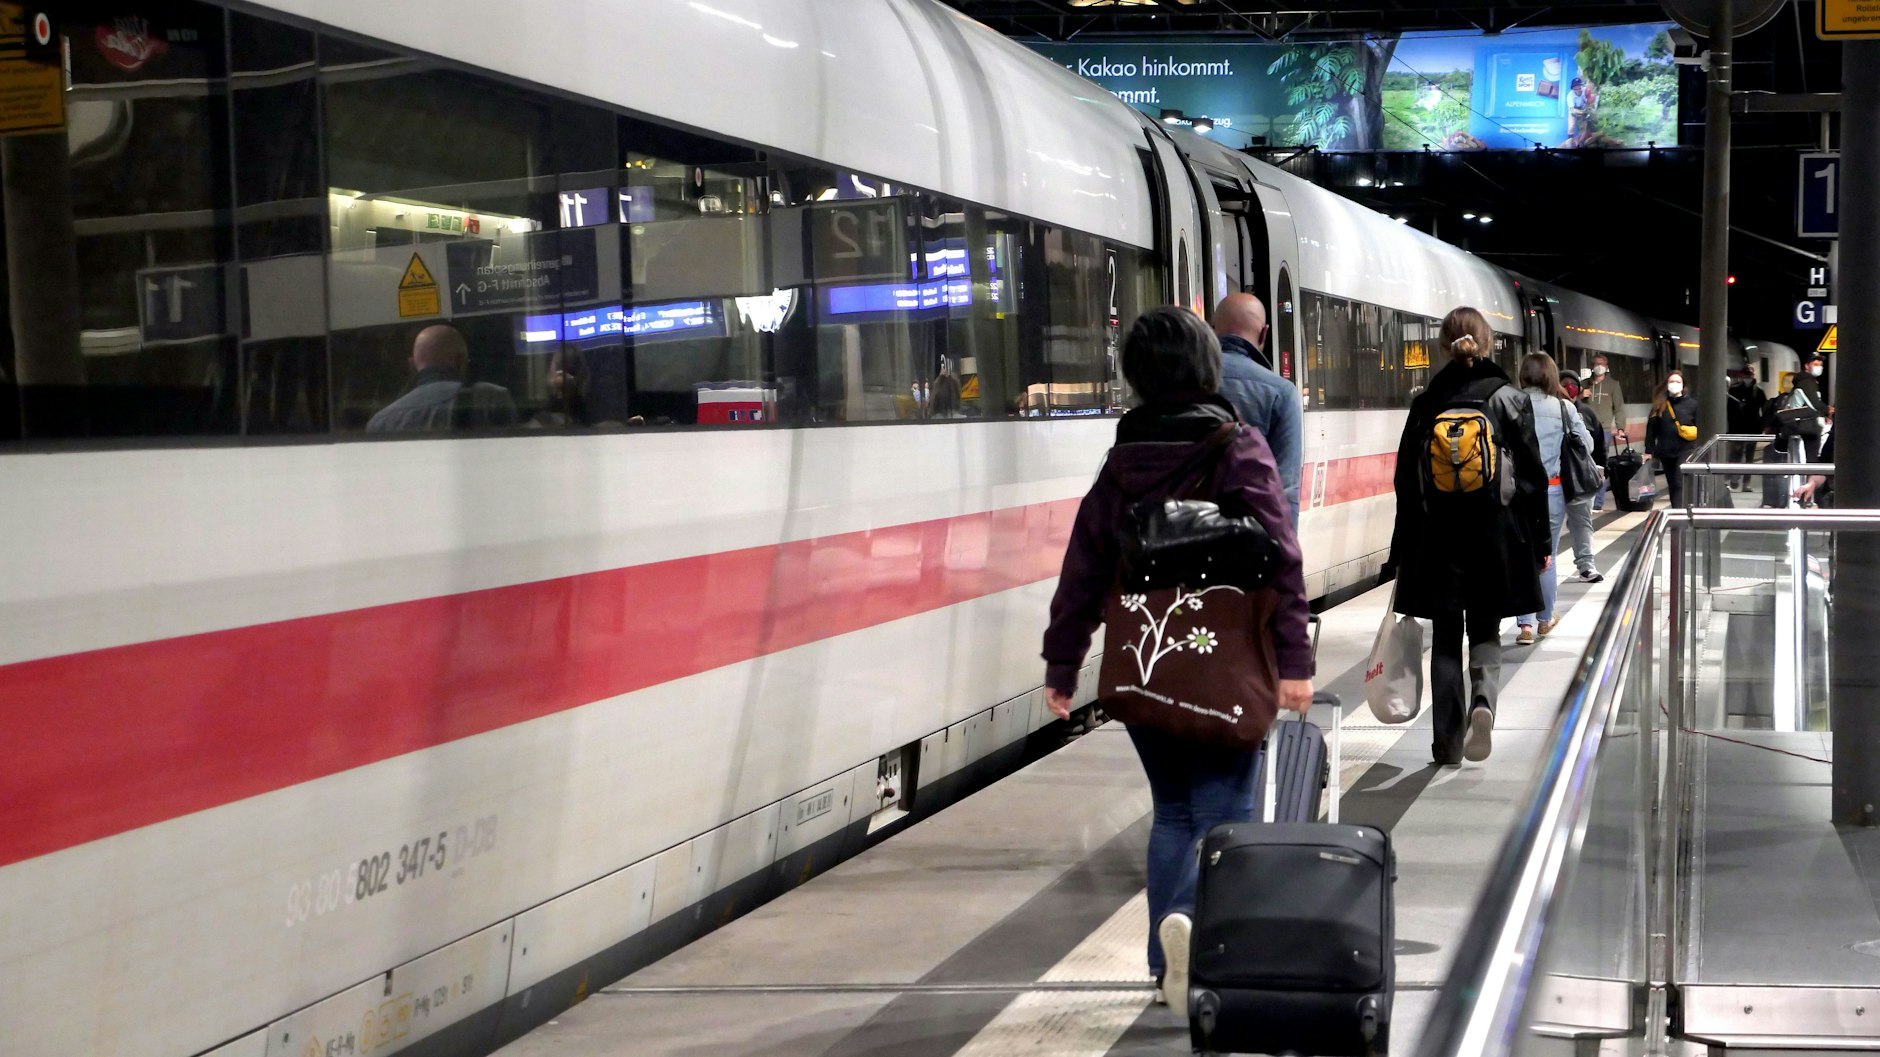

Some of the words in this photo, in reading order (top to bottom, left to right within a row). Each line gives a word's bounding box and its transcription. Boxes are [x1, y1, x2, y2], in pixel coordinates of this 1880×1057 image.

[1078, 56, 1137, 77] Kakao
[1142, 55, 1234, 77] hinkommt.
[1108, 255, 1118, 316] 2
[1810, 267, 1825, 285] H
[1796, 300, 1815, 323] G
[396, 831, 448, 885] 347-5
